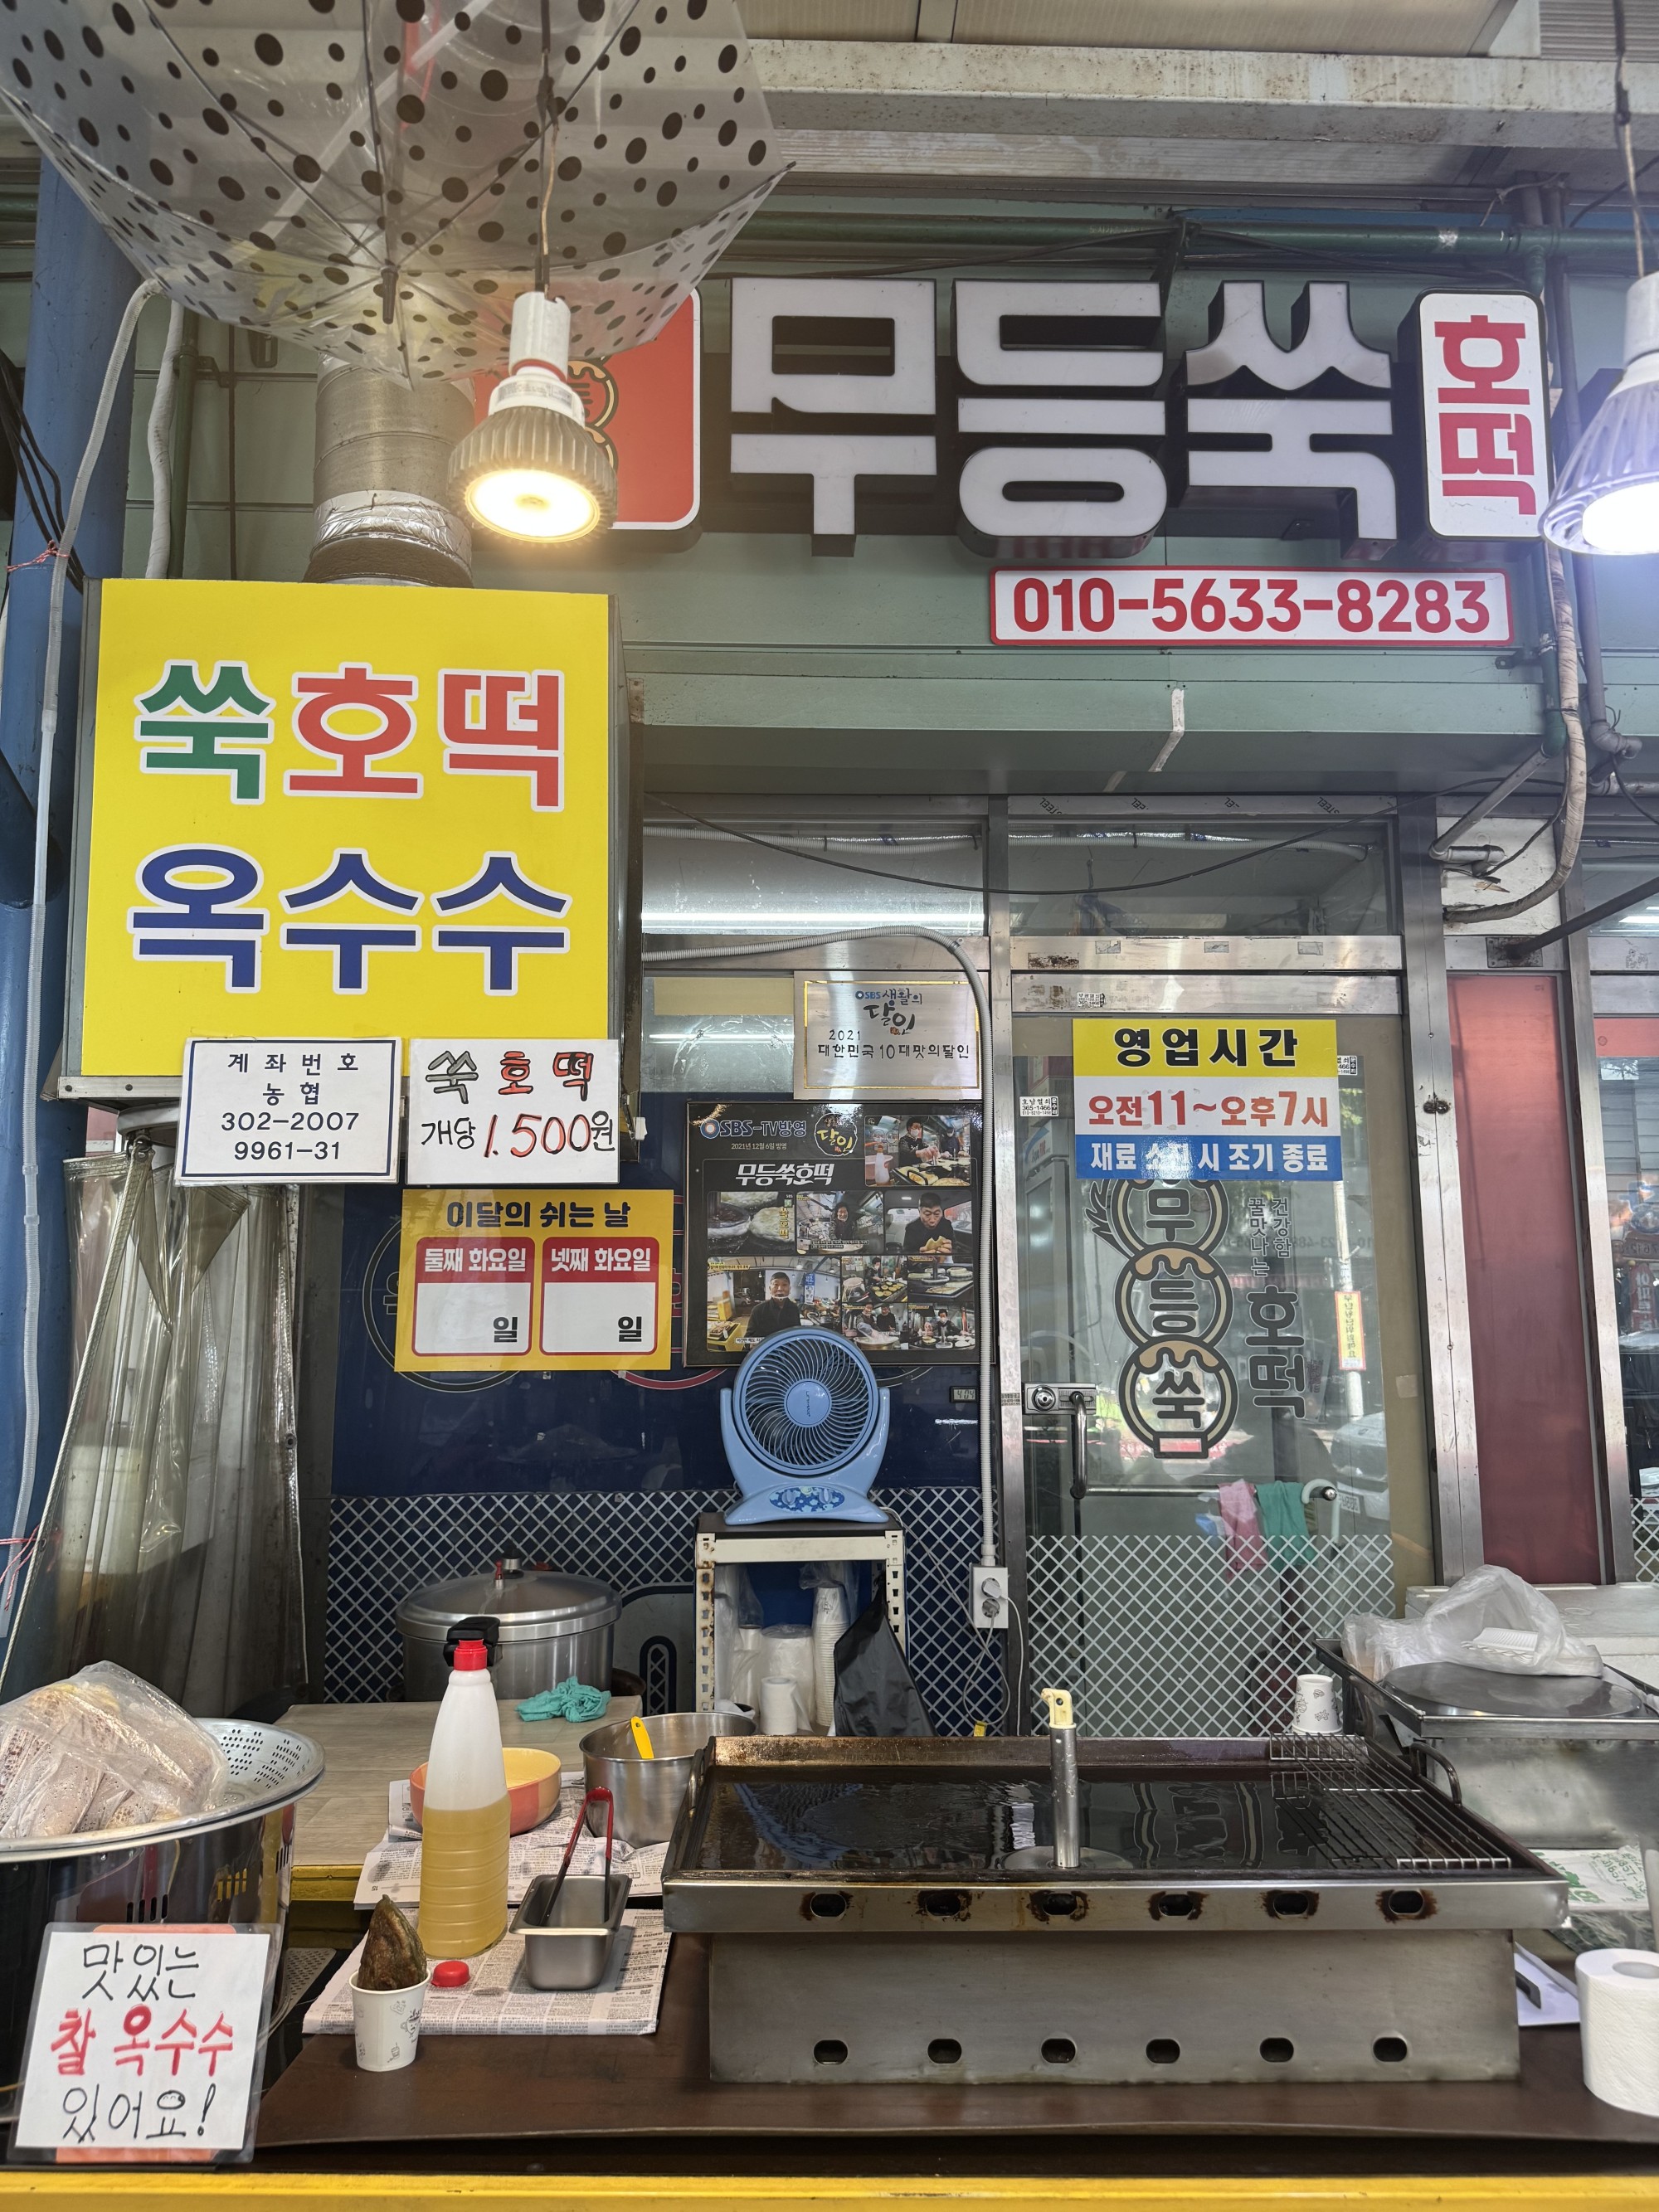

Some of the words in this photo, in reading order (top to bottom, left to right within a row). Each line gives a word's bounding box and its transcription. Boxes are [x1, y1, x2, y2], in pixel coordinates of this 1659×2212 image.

[731, 279, 1398, 541] 무등쑥
[1434, 315, 1536, 515] 호떡
[1013, 576, 1491, 634] 010-5633-8283
[135, 660, 564, 811] 쑥호떡
[128, 843, 572, 995] 옥수수
[883, 988, 922, 1006] 생활의
[864, 1002, 916, 1035] 달인
[829, 1029, 861, 1041] 2021
[1114, 1028, 1298, 1067] 영업시간
[227, 1052, 360, 1077] 계좌번호
[818, 1043, 874, 1059] 대한민국
[425, 1050, 593, 1104] 쑥호떡
[262, 1081, 320, 1106] 농협
[221, 1111, 360, 1132] 302-2007
[421, 1116, 476, 1150] 개당
[720, 1120, 806, 1137] SBS-TV방영
[233, 1140, 341, 1161] 9961-31
[1090, 1142, 1136, 1170] 재료
[1197, 1143, 1220, 1172] 시
[1228, 1143, 1274, 1172] 조기
[1282, 1144, 1328, 1172] 종료
[736, 1163, 835, 1186] 무등쑥호떡
[446, 1201, 531, 1228] 이달의
[539, 1201, 595, 1228] 쉬는
[604, 1201, 631, 1228] 날
[424, 1247, 463, 1272] 둘째
[469, 1247, 526, 1272] 화요일
[551, 1247, 589, 1272] 넷째
[594, 1247, 651, 1272] 화요일
[493, 1316, 518, 1344] 일
[617, 1315, 643, 1343] 일
[1245, 1285, 1305, 1419] 호떡
[81, 1940, 200, 2001] 맛있는
[51, 2007, 96, 2076] 찰
[114, 2003, 234, 2077] 옥수수
